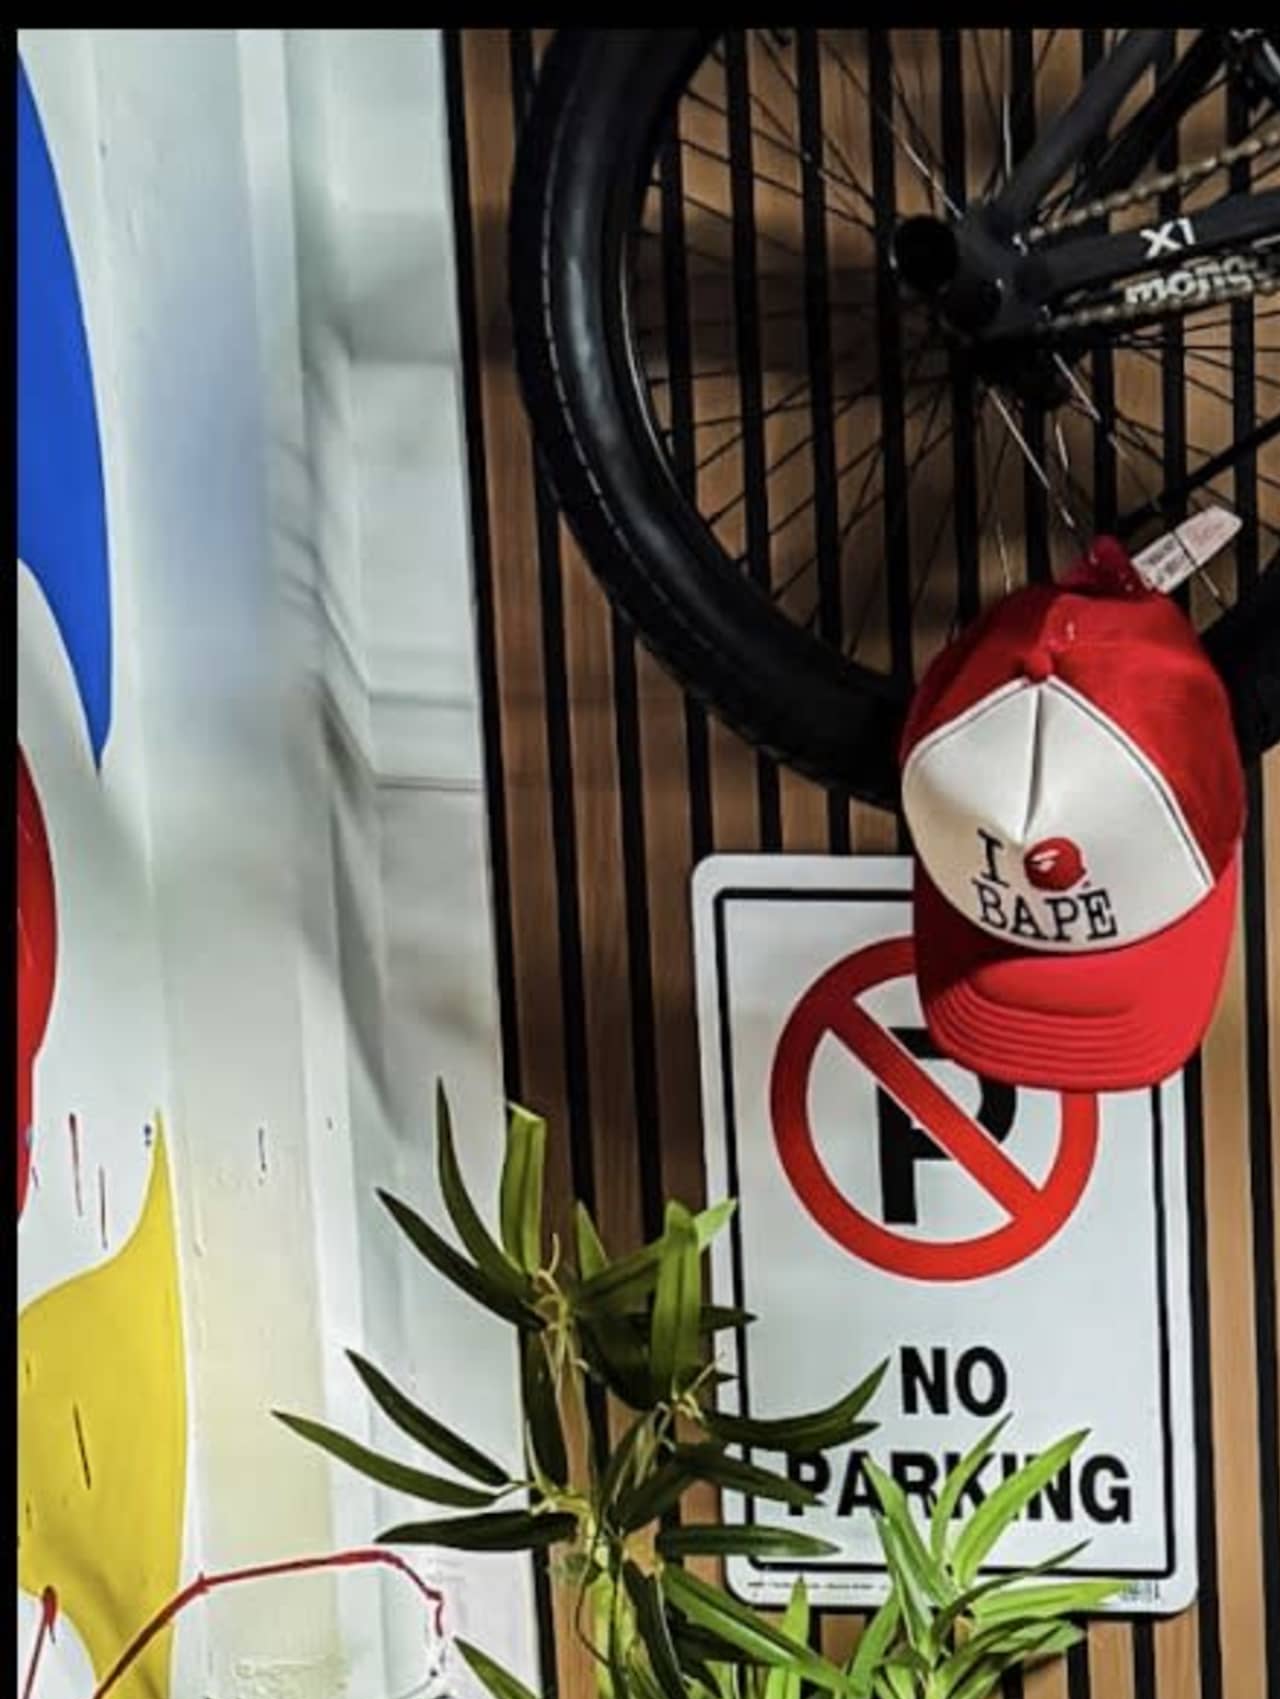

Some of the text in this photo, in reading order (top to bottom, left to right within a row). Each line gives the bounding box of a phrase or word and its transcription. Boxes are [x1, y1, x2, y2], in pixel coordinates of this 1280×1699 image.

[1140, 217, 1195, 258] X1
[973, 829, 1009, 887] I
[974, 881, 1118, 943] BAPE
[900, 1346, 1008, 1417] NO
